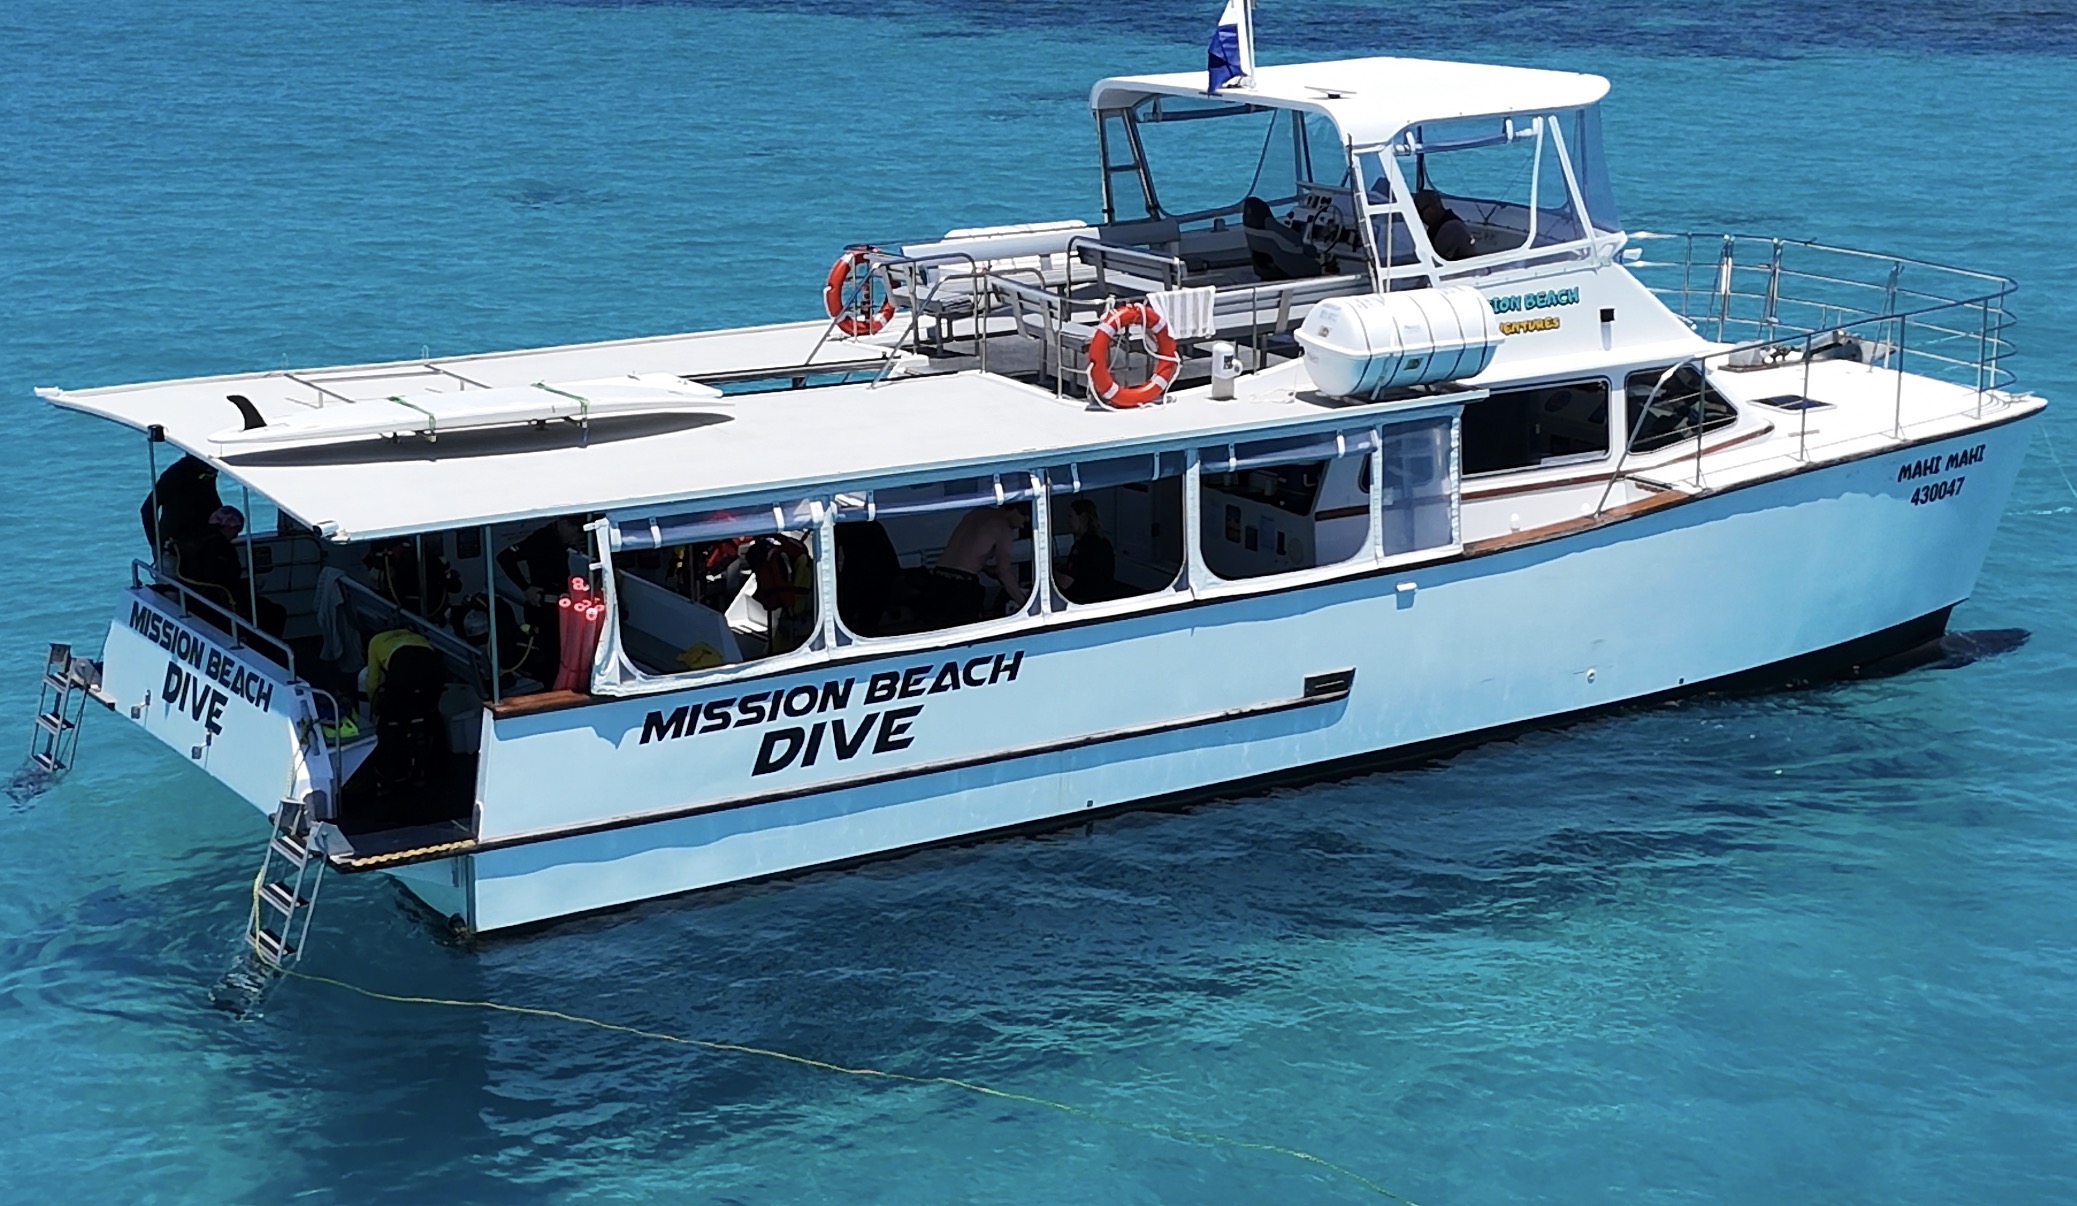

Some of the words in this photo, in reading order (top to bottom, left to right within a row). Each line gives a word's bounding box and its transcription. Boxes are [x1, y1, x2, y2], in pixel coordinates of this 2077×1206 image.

[1524, 286, 1580, 310] BEACH
[1897, 455, 1942, 483] MAHI
[1945, 444, 1986, 471] MAHI
[1910, 476, 1966, 506] 430047
[129, 600, 205, 670] MISSION
[205, 647, 274, 713] BEACH
[162, 660, 229, 736] DIVE
[639, 678, 855, 745] MISSION
[864, 650, 1024, 705] BEACH
[752, 704, 924, 777] DIVE
